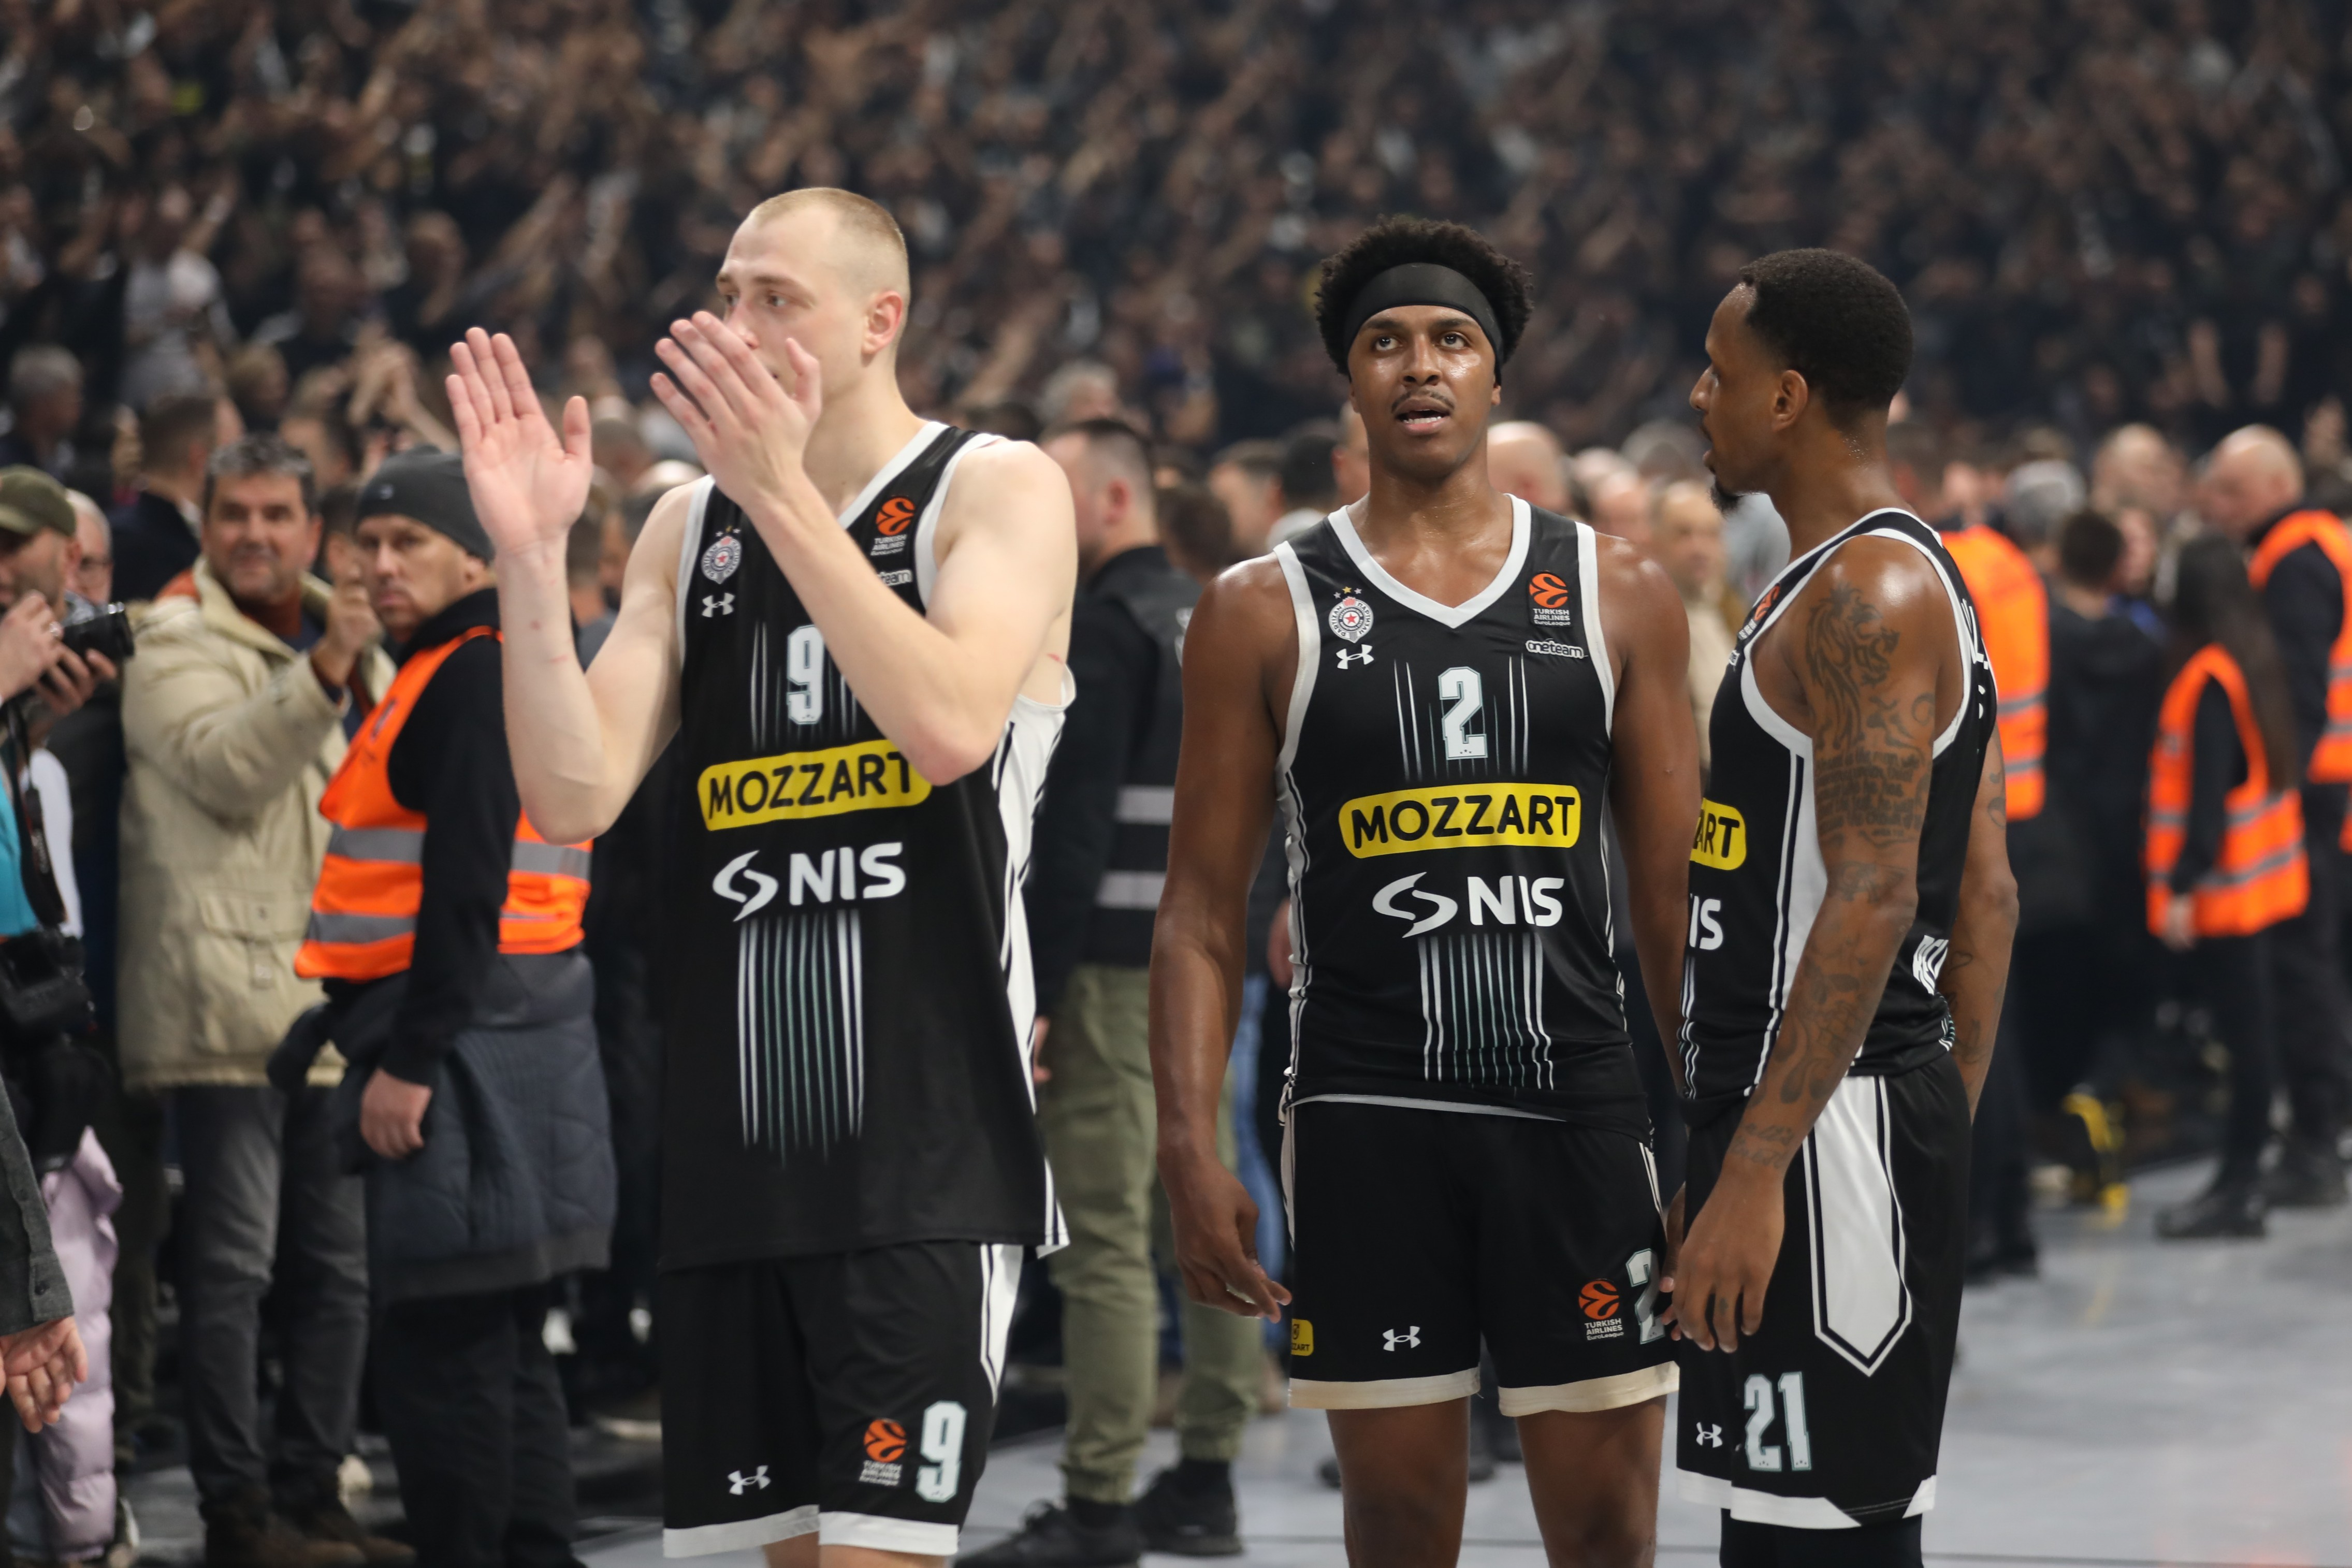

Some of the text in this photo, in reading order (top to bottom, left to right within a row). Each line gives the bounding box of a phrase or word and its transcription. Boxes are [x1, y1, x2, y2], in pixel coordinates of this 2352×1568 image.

[787, 625, 824, 725] 9
[1438, 666, 1488, 761] 2
[708, 751, 910, 820] MOZZART
[1352, 794, 1575, 849] MOZZART
[1693, 809, 1740, 858] ART
[790, 842, 906, 906] NIS
[1468, 876, 1565, 927] NIS
[1689, 894, 1724, 950] IS
[1585, 1318, 1622, 1329] TURKISH
[1625, 1248, 1665, 1344] 2
[1587, 1325, 1623, 1335] AIRLINES
[1587, 1332, 1624, 1341] EuroLeague
[915, 1400, 967, 1503] 9
[1744, 1371, 1812, 1472] 21
